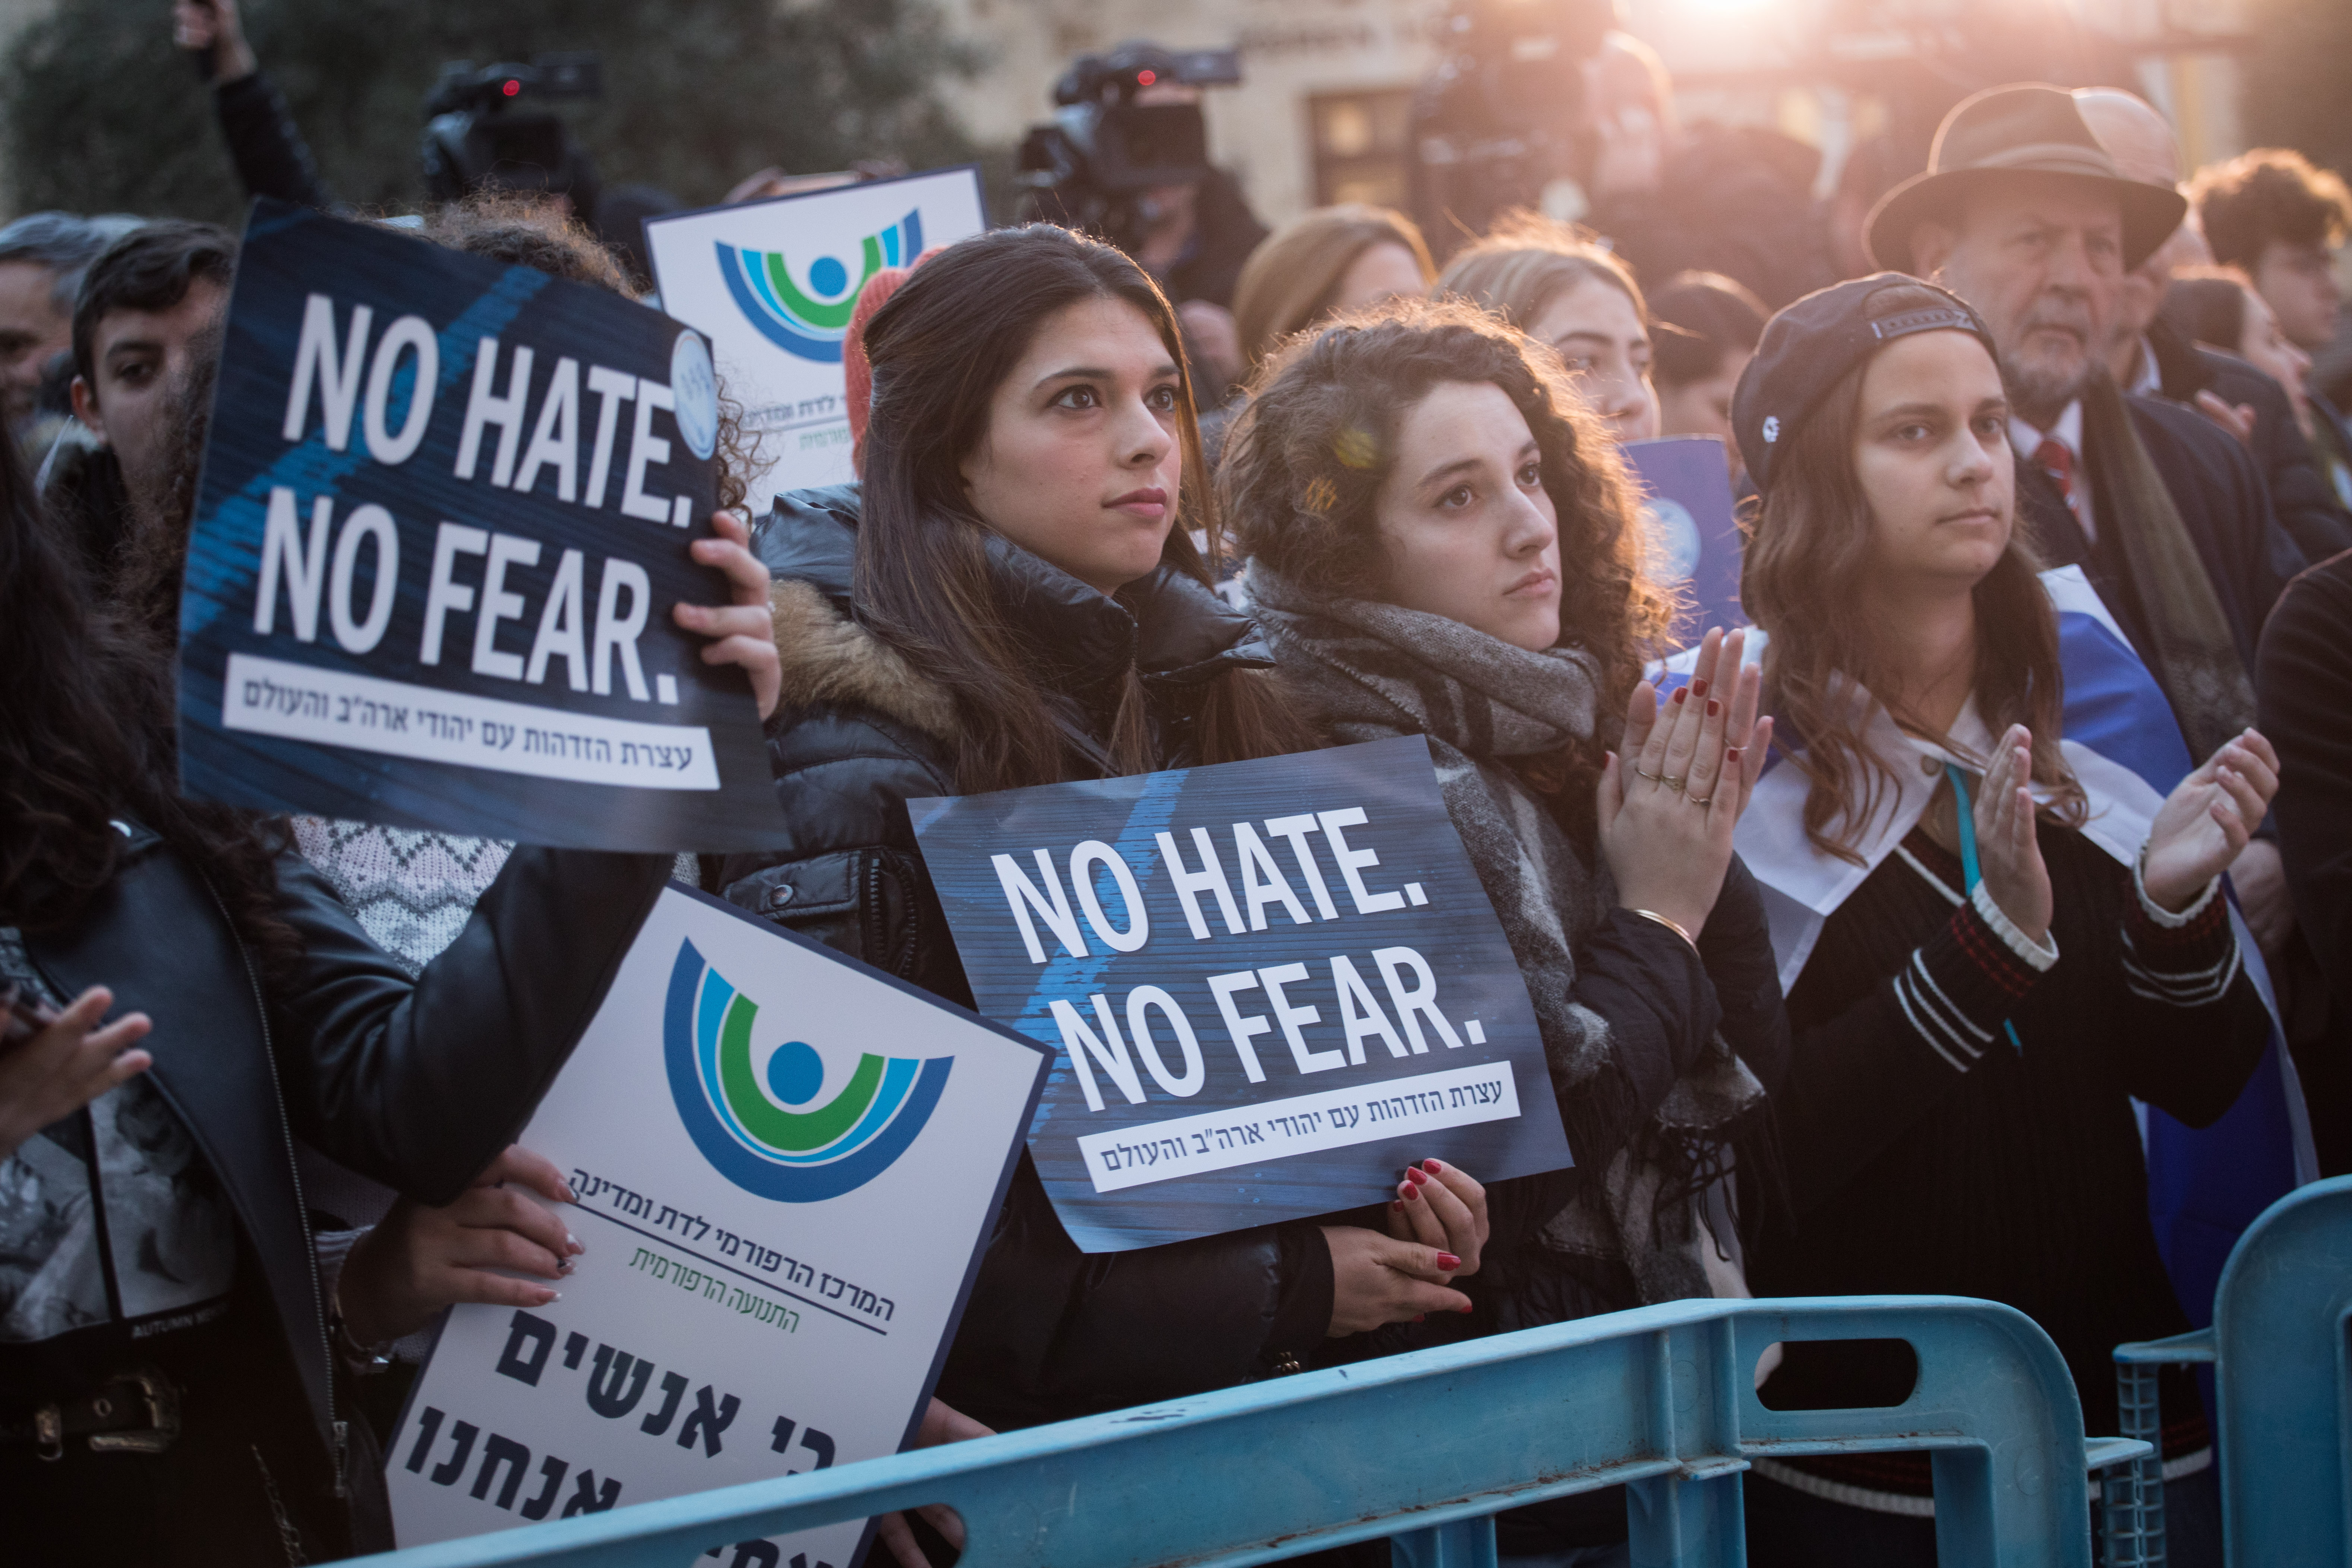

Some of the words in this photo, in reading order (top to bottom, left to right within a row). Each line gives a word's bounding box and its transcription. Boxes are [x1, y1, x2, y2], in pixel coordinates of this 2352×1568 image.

[282, 293, 439, 464] NO
[454, 336, 692, 528] HATE.
[254, 485, 399, 653] NO
[419, 521, 678, 704] FEAR.
[243, 678, 329, 719] והעולם
[416, 710, 473, 742] יהודי
[482, 720, 515, 751] עם
[524, 728, 611, 763] הזדהות
[621, 742, 692, 771] עצרת
[991, 840, 1149, 963] NO
[1155, 807, 1429, 939] HATE.
[1048, 985, 1205, 1112] NO
[1207, 946, 1487, 1083] FEAR.
[1367, 1091, 1445, 1121] הזדהות
[1449, 1080, 1502, 1108] עצרת
[1267, 1112, 1322, 1137] יהודי
[1327, 1105, 1359, 1129] עם
[1100, 1137, 1187, 1171] והעולם
[568, 1168, 653, 1219] ומדינה
[654, 1205, 711, 1241] לדת
[629, 1247, 726, 1303] הרפורמית
[716, 1229, 814, 1287] הרפורמי
[727, 1288, 800, 1333] התנועה
[820, 1272, 894, 1321] המרכז
[495, 1309, 741, 1459] אנשים
[405, 1406, 622, 1520] אנחנו
